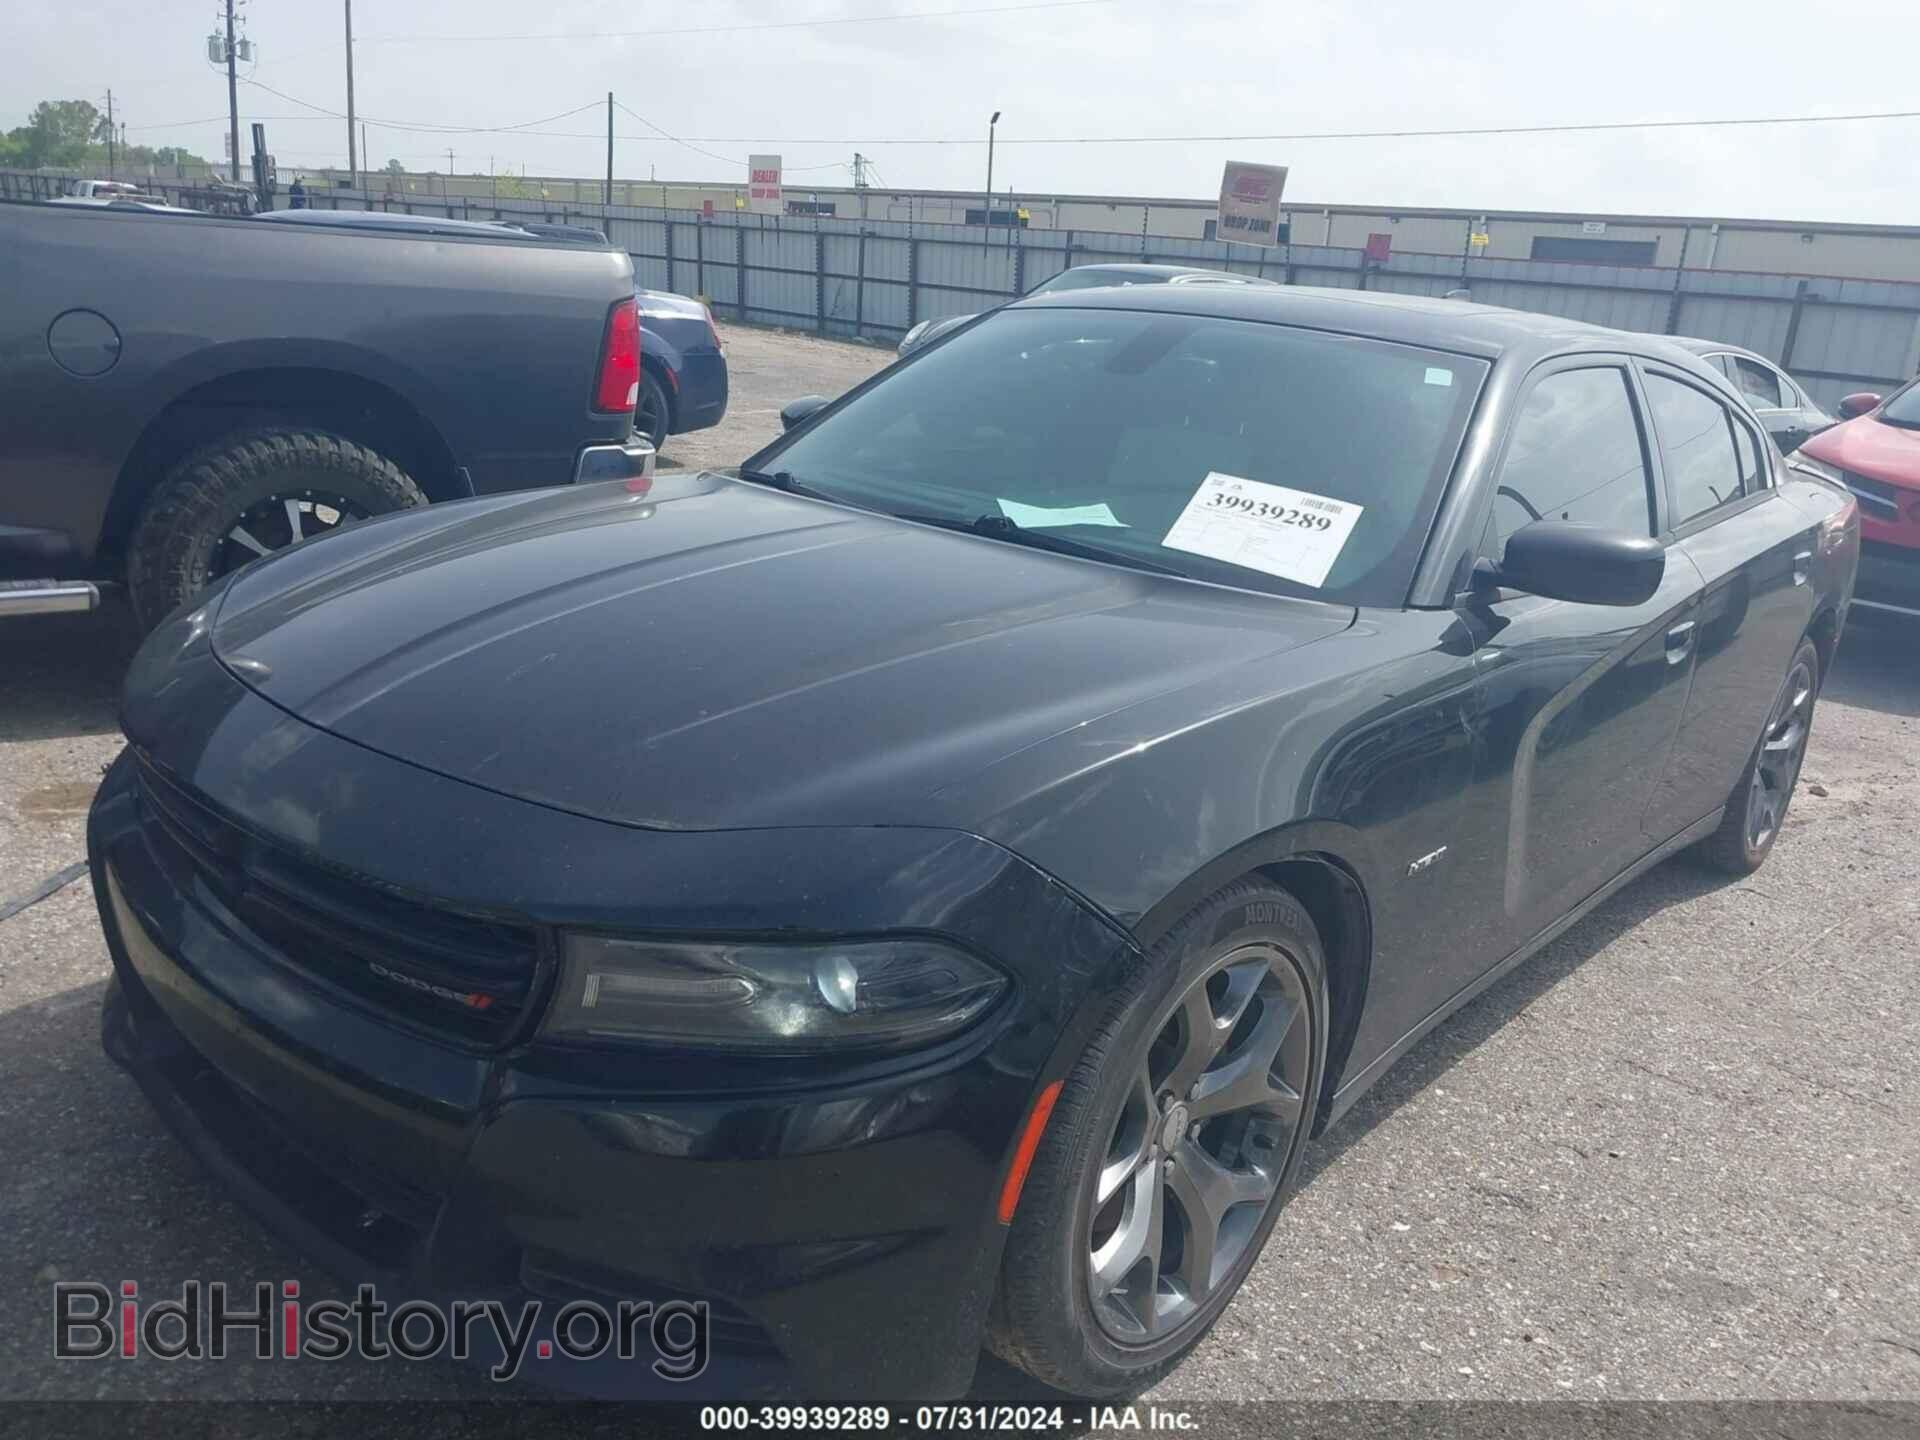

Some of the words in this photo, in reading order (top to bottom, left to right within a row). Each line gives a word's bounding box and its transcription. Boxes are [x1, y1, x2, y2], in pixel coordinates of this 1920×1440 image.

[752, 169, 778, 183] DEALER
[1224, 215, 1248, 229] DROP
[1248, 217, 1271, 233] ZONE
[1207, 492, 1331, 532] 39939289
[369, 962, 466, 1003] DODGE
